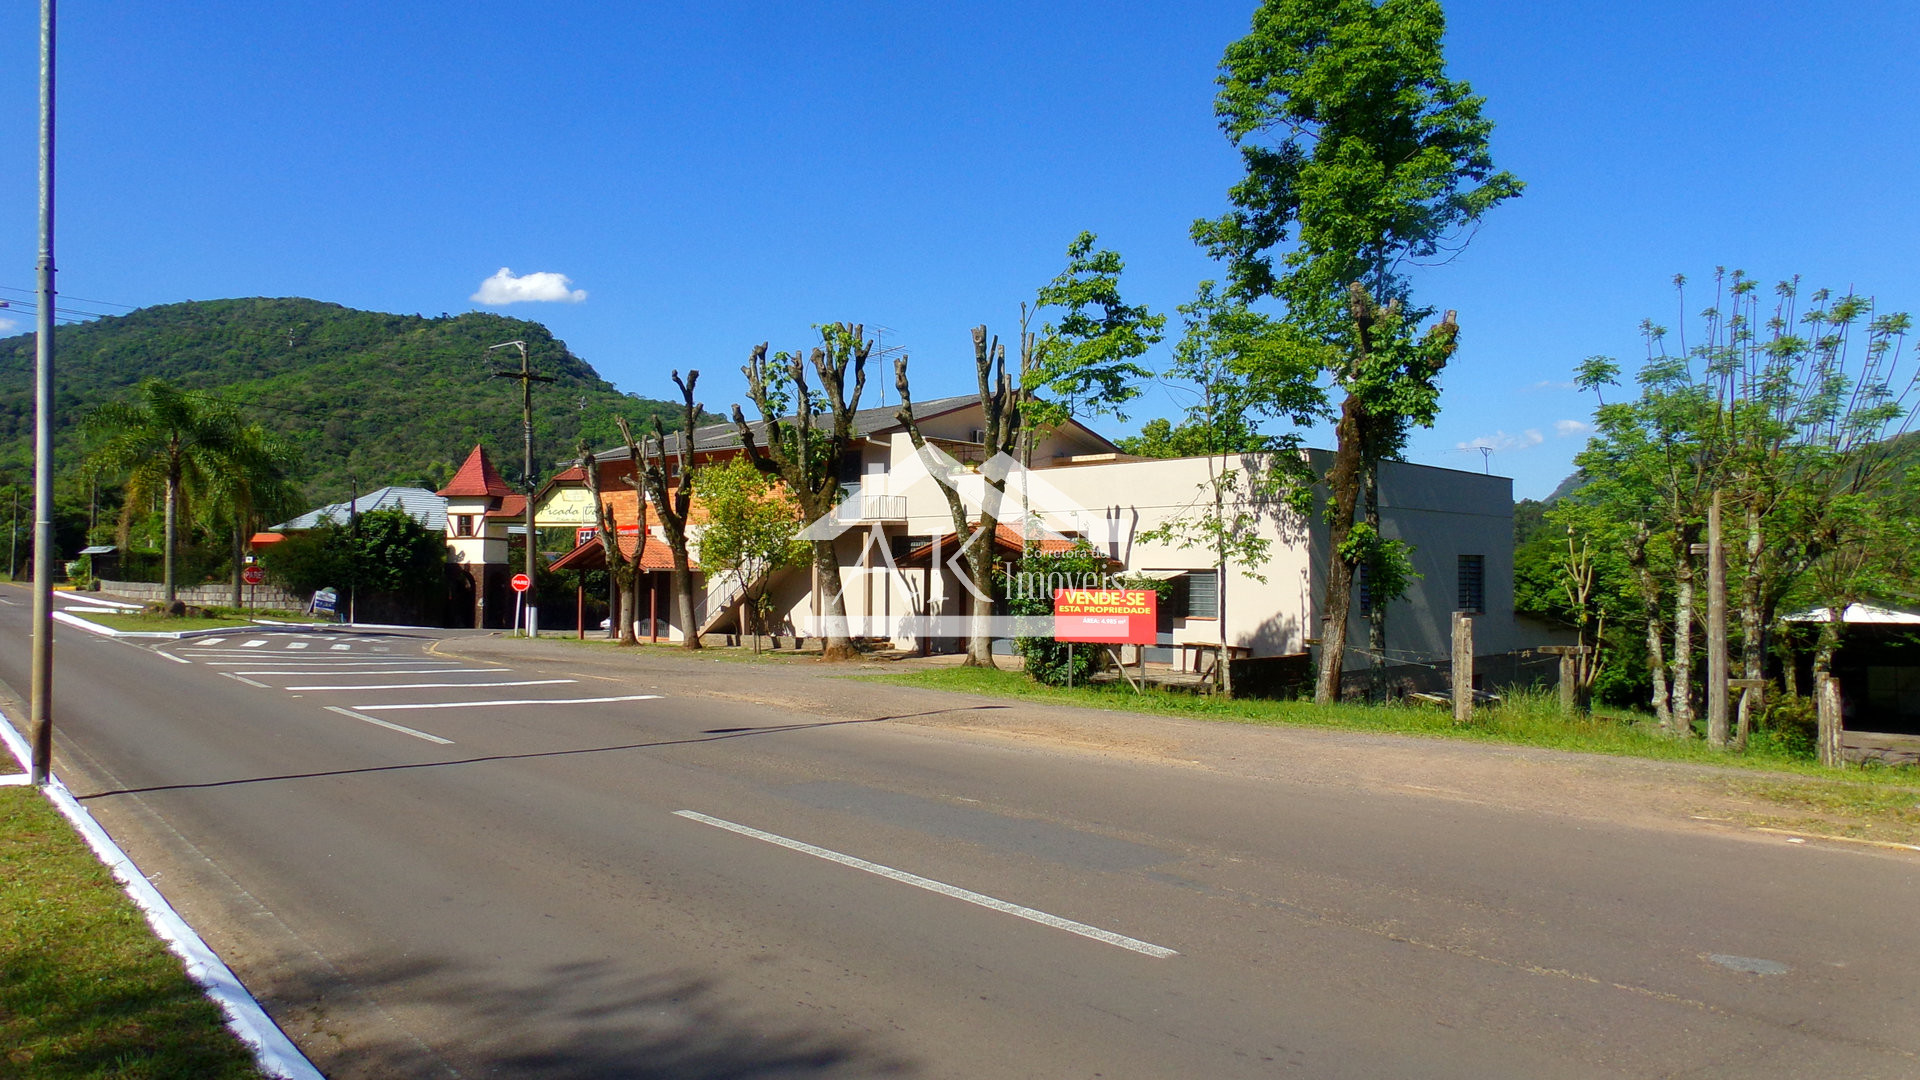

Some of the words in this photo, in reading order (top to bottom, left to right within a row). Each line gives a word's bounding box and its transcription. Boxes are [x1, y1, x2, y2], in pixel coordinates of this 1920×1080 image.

[540, 503, 579, 515] Picada
[245, 571, 264, 579] PARE
[1065, 592, 1144, 605] VENDE-SE
[1059, 605, 1081, 613] ESTA
[1085, 606, 1151, 614] PROPRIEDADE
[1083, 616, 1100, 624] ÁREA:
